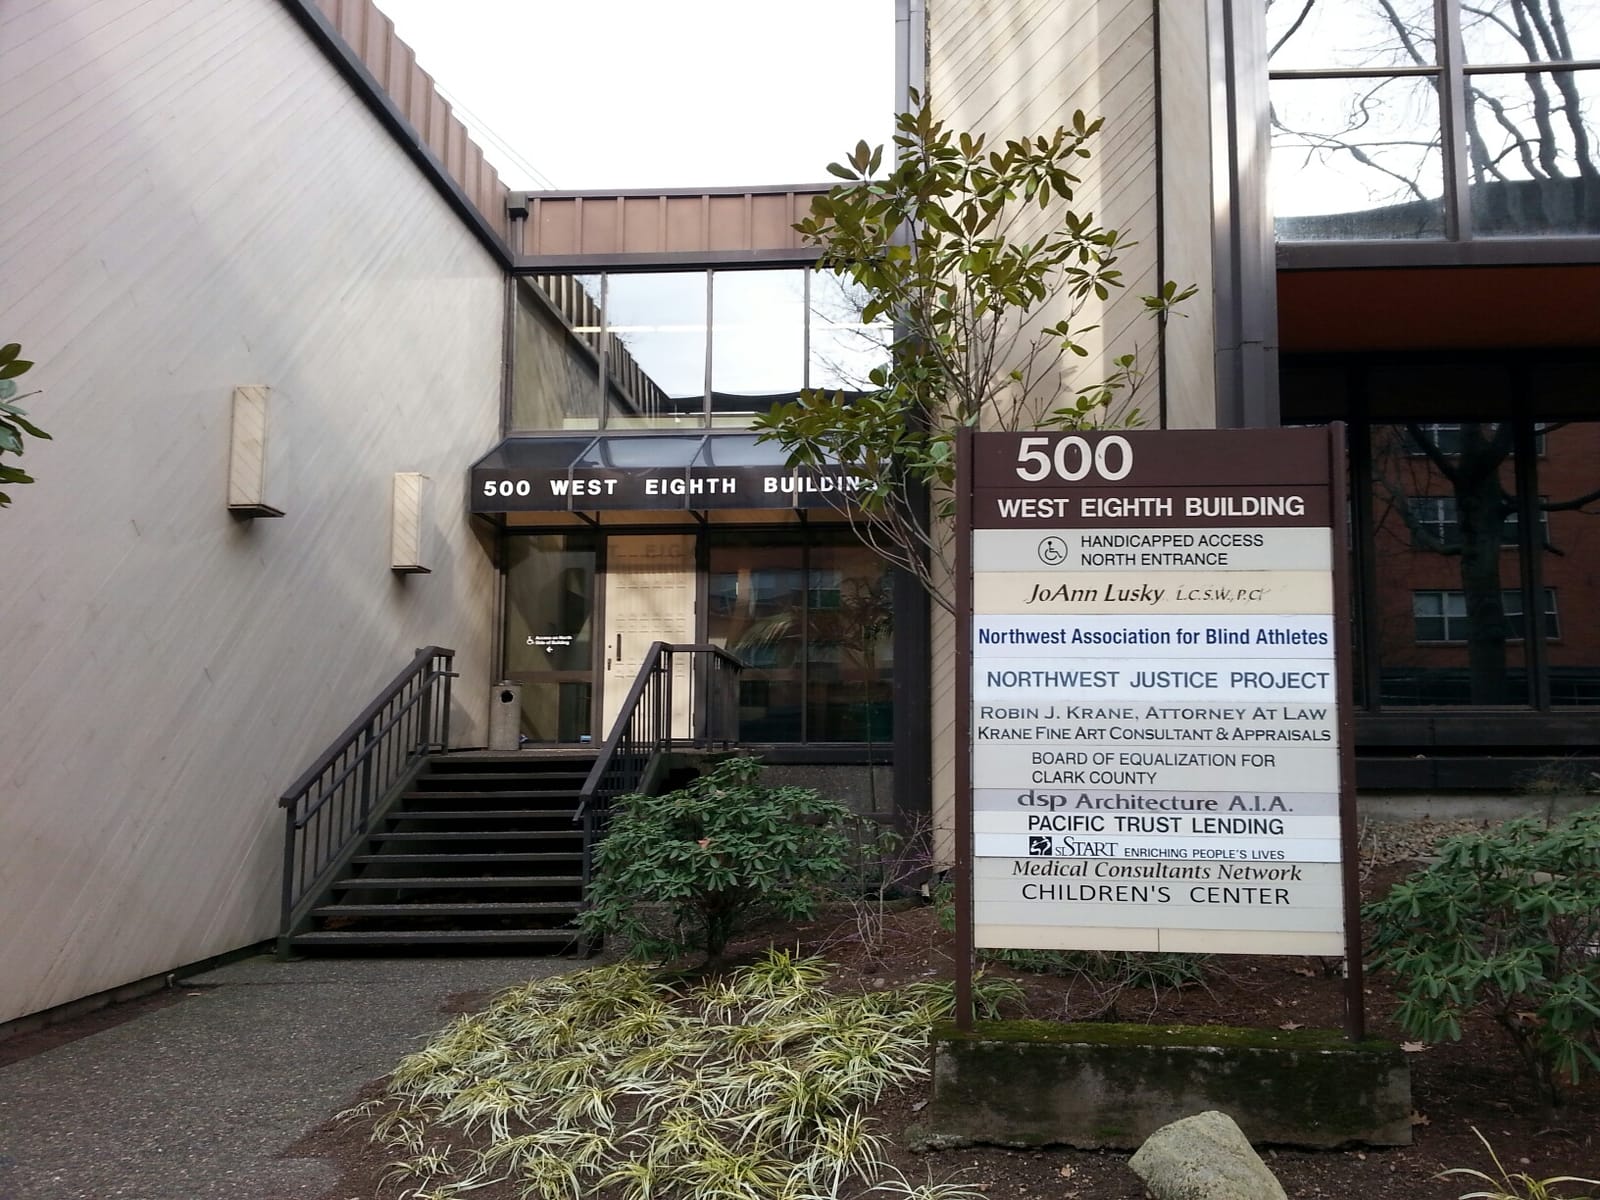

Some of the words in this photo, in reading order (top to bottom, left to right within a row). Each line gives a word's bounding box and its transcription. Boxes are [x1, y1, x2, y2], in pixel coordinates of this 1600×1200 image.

[1016, 436, 1133, 482] 500
[483, 480, 530, 496] 500
[550, 480, 618, 496] WEST
[645, 478, 736, 495] EIGHTH
[998, 499, 1069, 518] WEST
[1081, 498, 1172, 517] EIGHTH
[1186, 496, 1304, 516] BUILDING
[1081, 535, 1194, 548] HANDICAPPED
[1198, 534, 1263, 547] ACCESS
[1081, 553, 1136, 566] NORTH
[1142, 553, 1228, 566] ENTRANCE
[1025, 584, 1098, 604] JoAnn
[1104, 584, 1165, 604] Lusky
[979, 629, 1066, 644] Northwest
[1072, 629, 1170, 644] Association
[1176, 629, 1200, 644] for
[1206, 629, 1250, 644] Blind
[1256, 629, 1328, 645] Athletes
[987, 672, 1120, 688] NORTHWEST
[1130, 672, 1218, 688] JUSTICE
[1231, 672, 1330, 688] PROJECT
[1032, 752, 1088, 765] BOARD
[1092, 752, 1115, 765] OF
[1120, 753, 1236, 767] EQUALIZATION
[1241, 754, 1275, 767] FOR
[1032, 771, 1085, 783] CLARK
[1089, 771, 1157, 784] COUNTY
[1018, 789, 1067, 811] dsp
[1076, 794, 1218, 811] Architecture
[1228, 796, 1293, 812] A.I.A.
[1028, 815, 1104, 831] PACIFIC
[1114, 817, 1182, 832] TRUST
[1192, 818, 1284, 834] LENDING
[1124, 848, 1188, 858] ENRICHING
[1192, 849, 1247, 859] PEOPLE'S
[1252, 850, 1284, 859] LIVES
[1012, 861, 1088, 877] Medical
[1095, 862, 1210, 879] Consultants
[1217, 864, 1302, 881] Network
[1022, 884, 1171, 902] CHILDREN'S
[1190, 887, 1290, 904] CENTER
